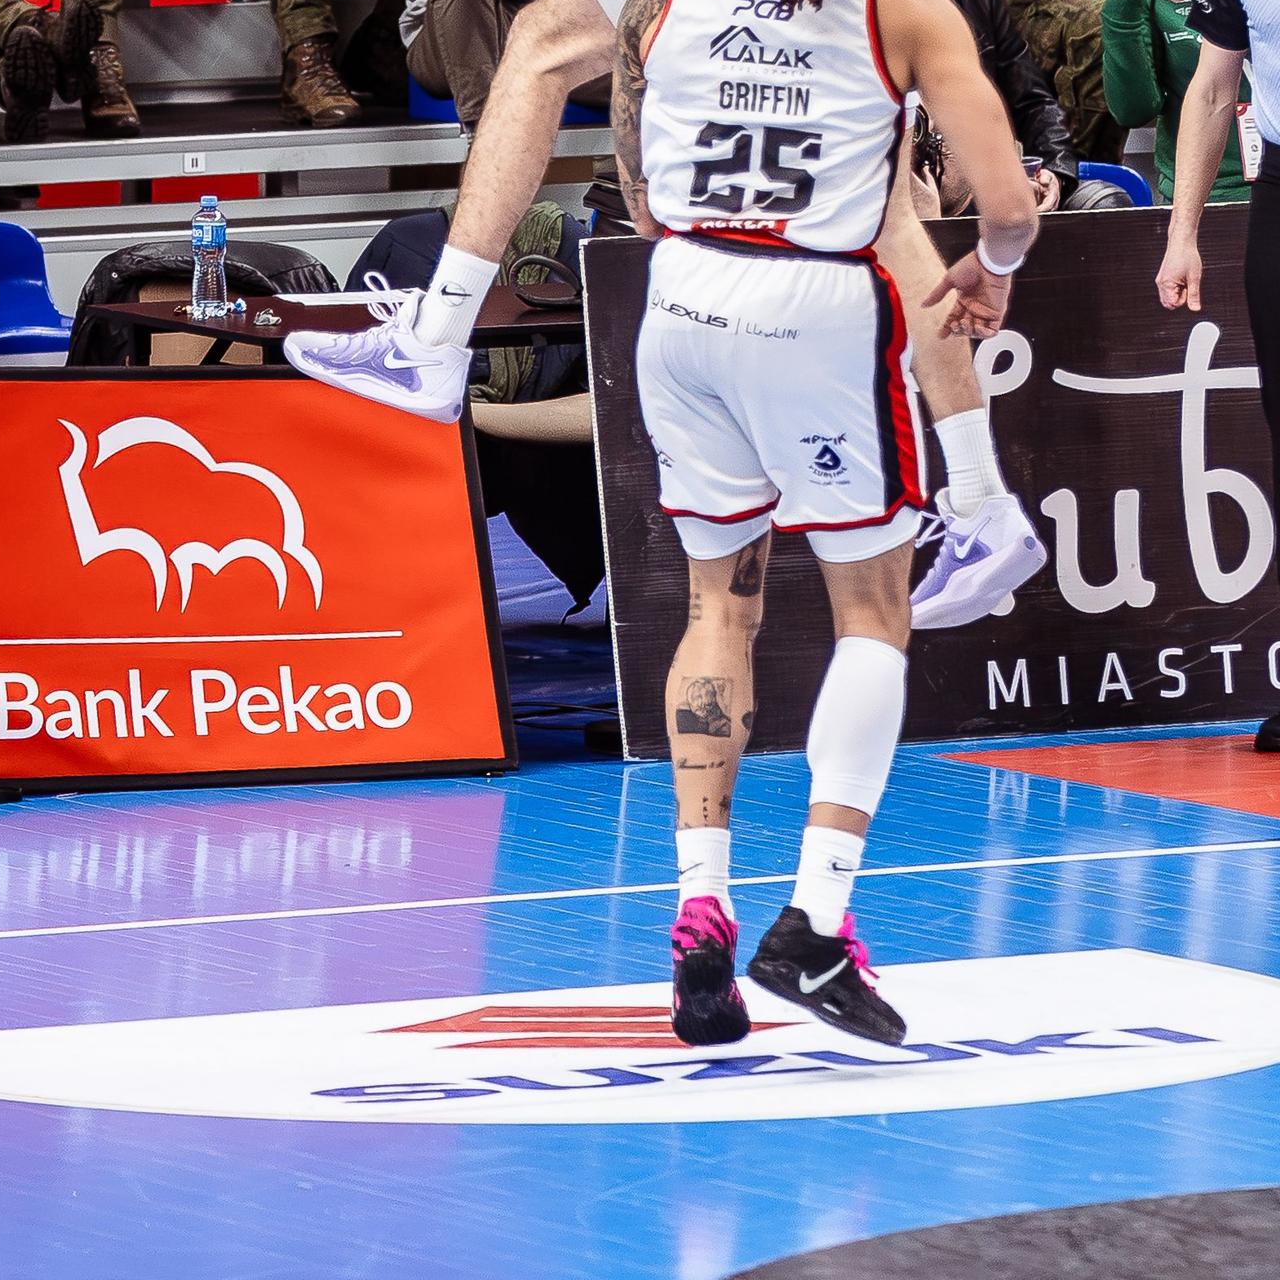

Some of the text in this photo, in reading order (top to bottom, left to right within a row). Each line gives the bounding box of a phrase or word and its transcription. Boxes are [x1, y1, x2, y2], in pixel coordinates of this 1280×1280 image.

[719, 80, 811, 117] GRIFFIN
[689, 122, 822, 214] 25
[660, 298, 729, 329] LEXUS
[190, 665, 413, 738] Pekao
[312, 1026, 1219, 1105] SUZUKI
